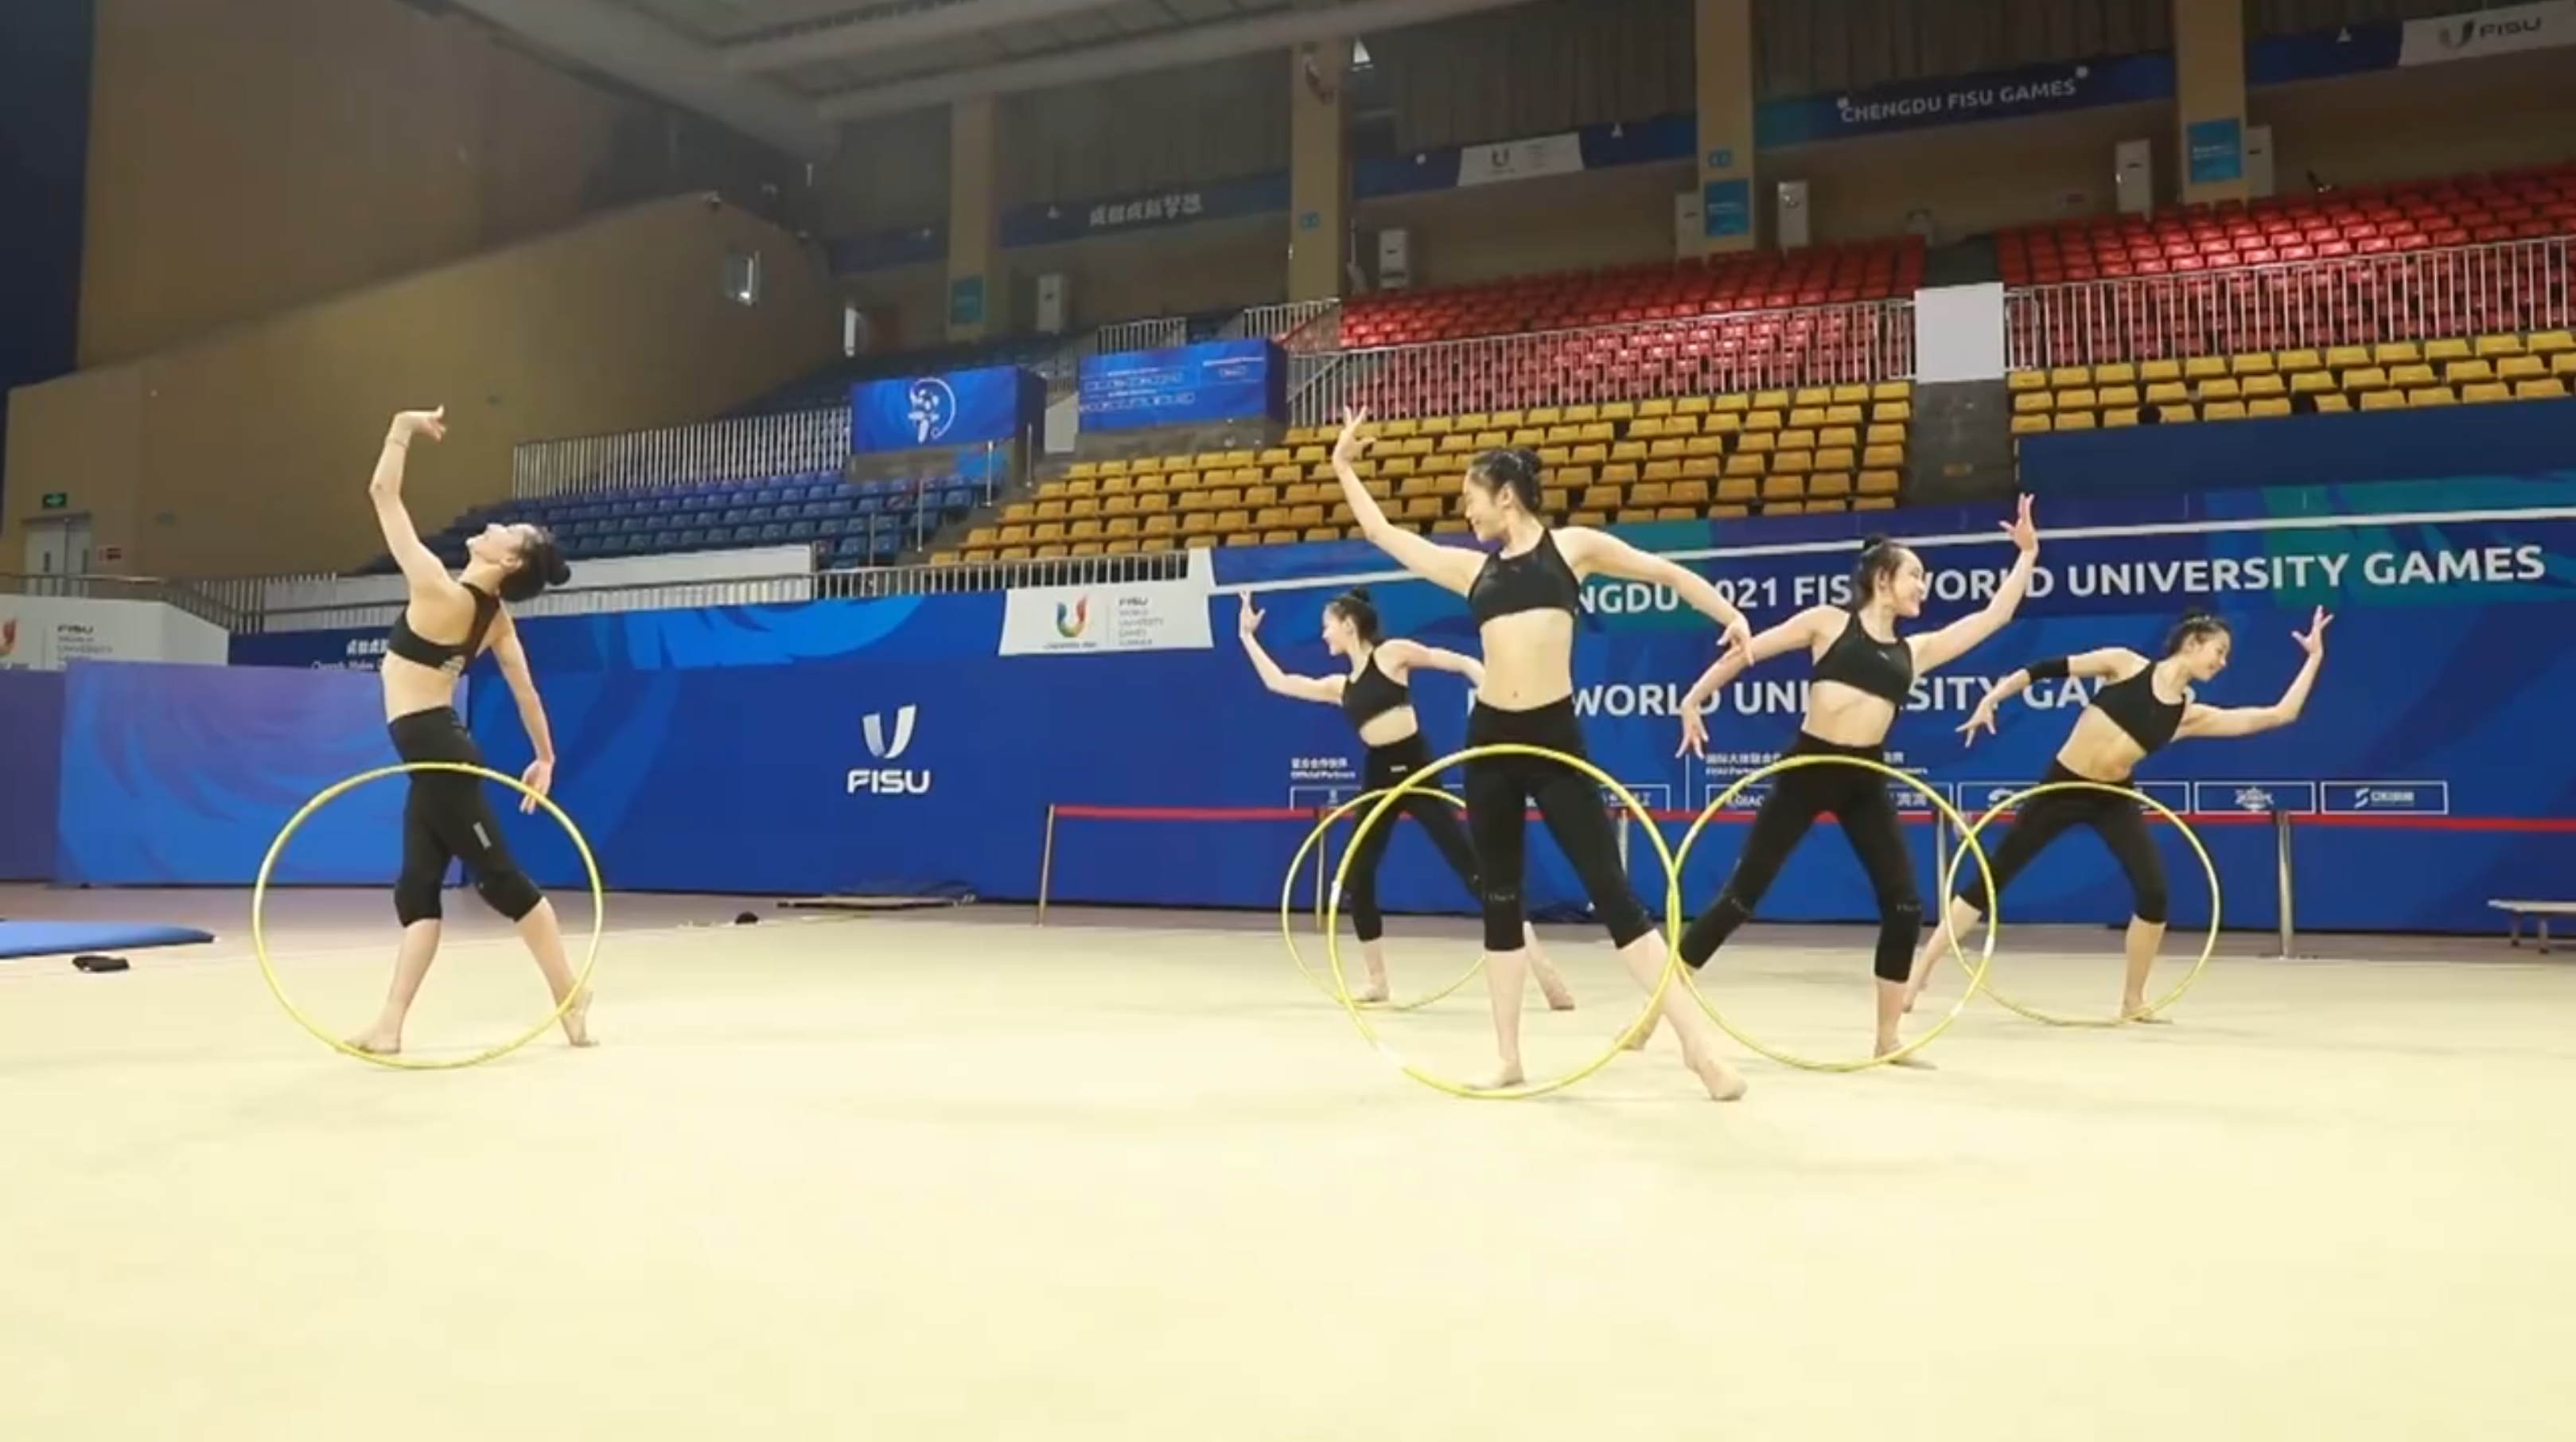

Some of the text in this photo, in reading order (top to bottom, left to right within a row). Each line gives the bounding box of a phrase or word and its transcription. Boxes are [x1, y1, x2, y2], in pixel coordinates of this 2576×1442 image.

[2480, 17, 2542, 38] FISU
[1841, 78, 2076, 122] CHENGDU FISU GAMES
[1576, 581, 1679, 614] NGDU
[1715, 576, 1777, 608] 021
[1794, 575, 1853, 606] FIS
[2068, 554, 2349, 597] UNIVERSITY
[2364, 545, 2546, 586] GAMES
[846, 769, 930, 794] FISU
